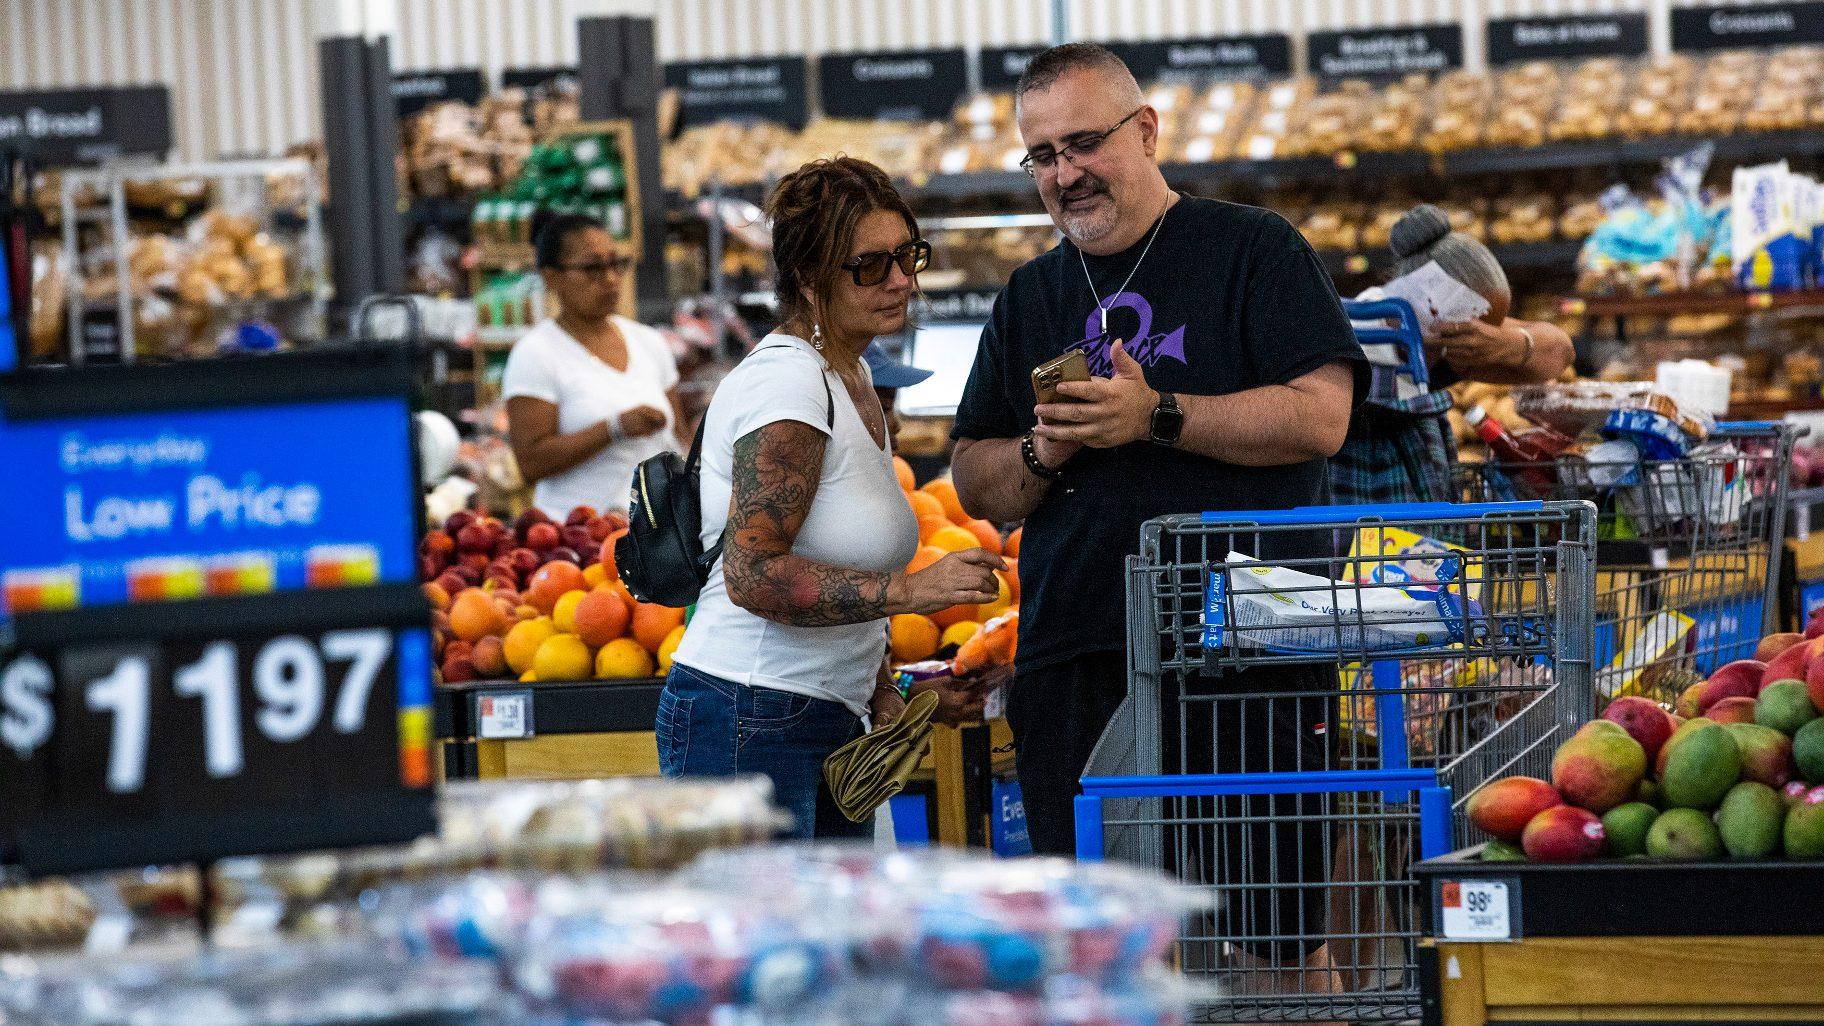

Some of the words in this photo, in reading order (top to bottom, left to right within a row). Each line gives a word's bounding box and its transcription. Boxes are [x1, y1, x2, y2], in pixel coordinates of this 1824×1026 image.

[26, 106, 102, 137] Bread
[61, 433, 208, 475] Everyday
[66, 486, 174, 540] Low
[187, 473, 320, 530] Price
